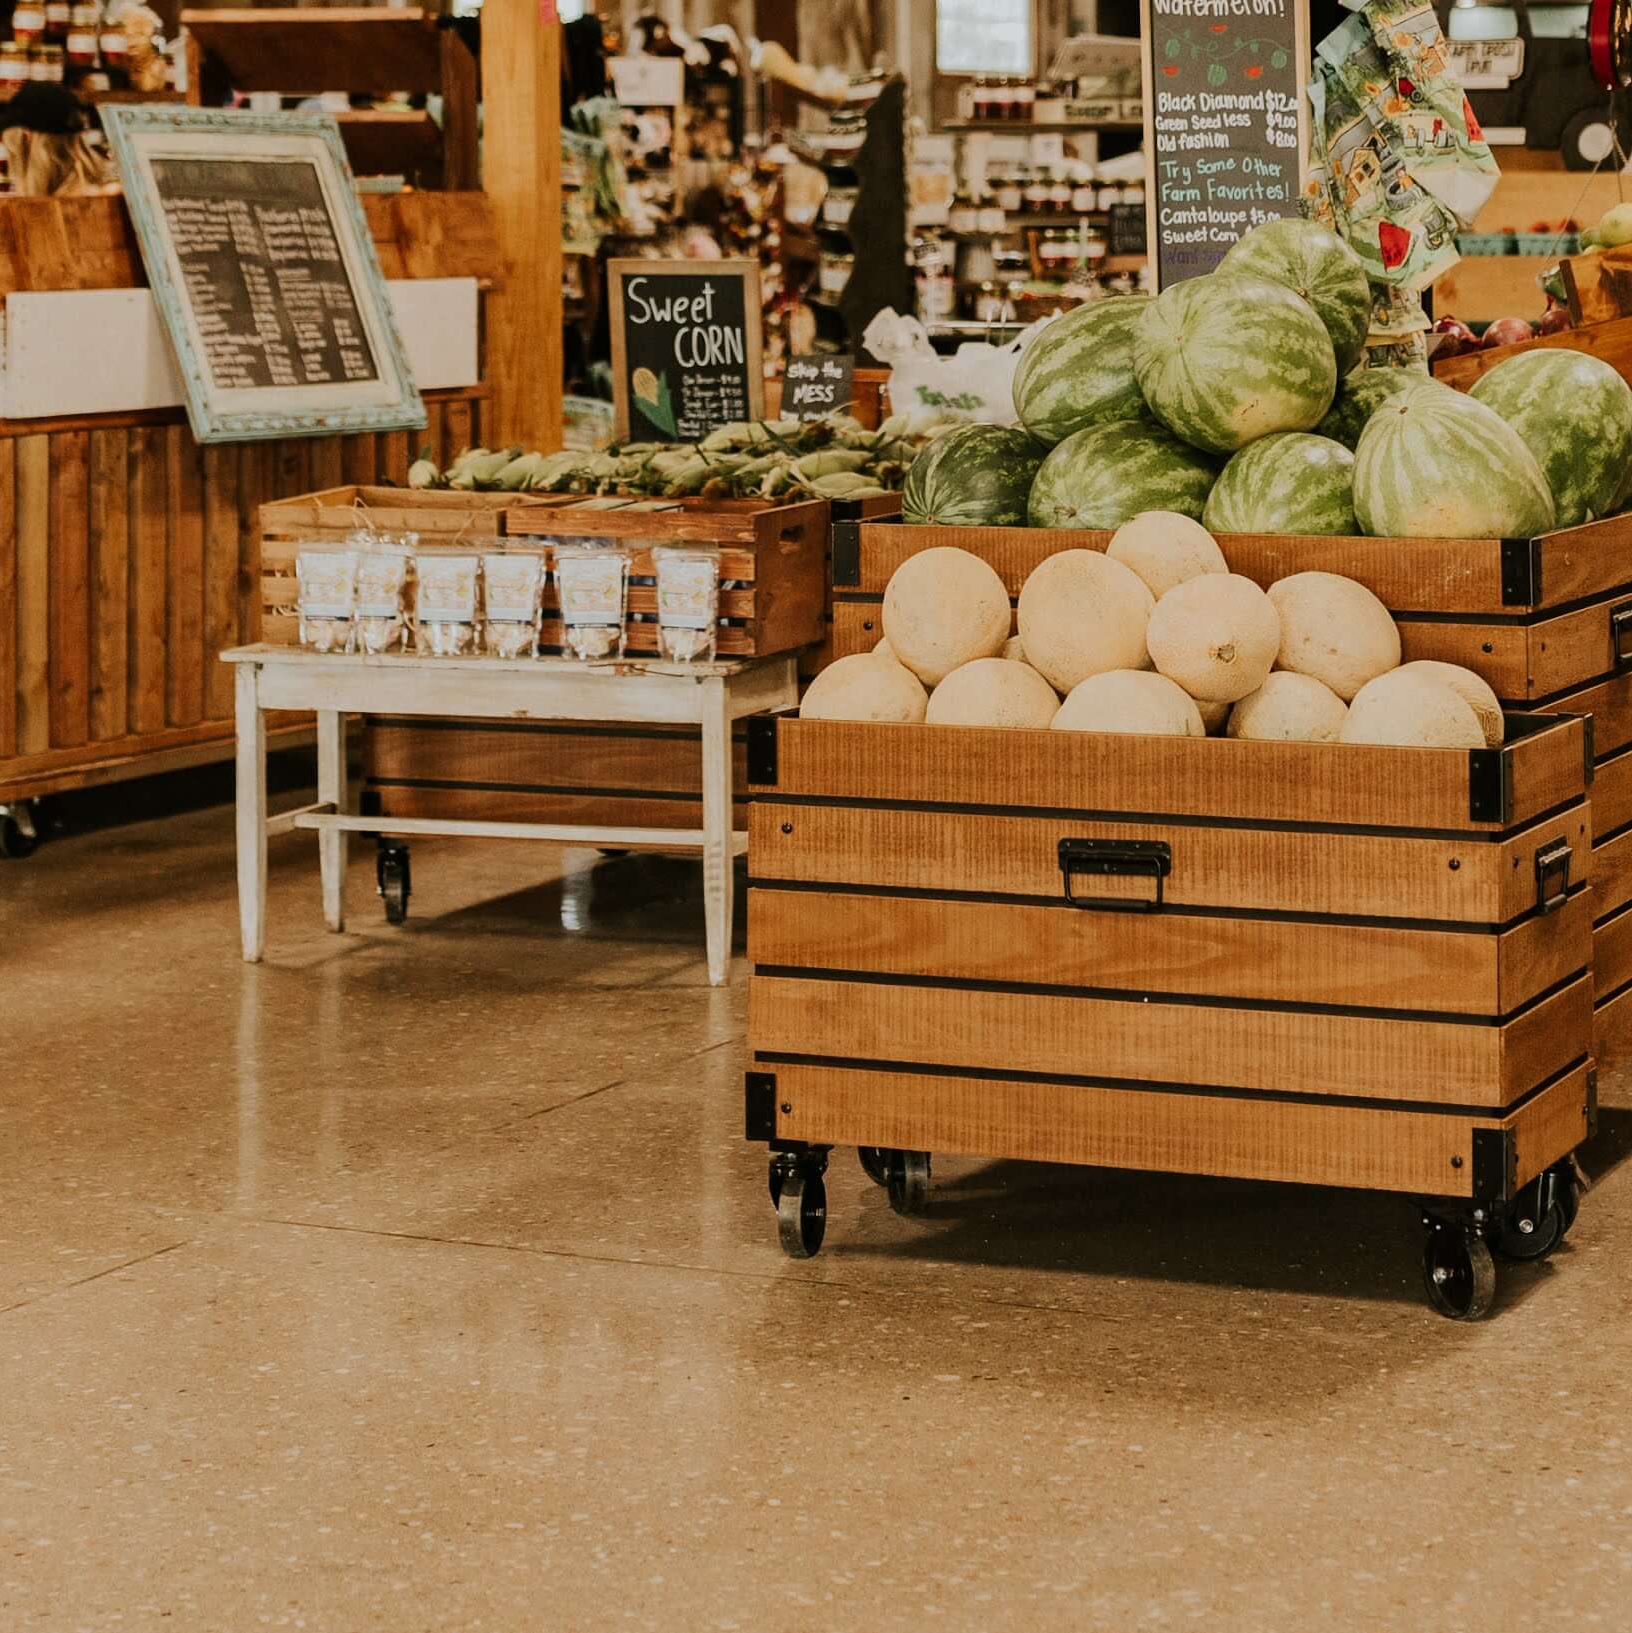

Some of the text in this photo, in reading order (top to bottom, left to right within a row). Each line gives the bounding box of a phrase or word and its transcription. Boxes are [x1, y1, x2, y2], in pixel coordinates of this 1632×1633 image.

[1158, 92, 1196, 112] Black
[1199, 90, 1265, 112] Diamond
[1155, 115, 1188, 130] Green
[1157, 134, 1177, 152] Old
[1160, 157, 1282, 185] Try Some Other
[1161, 177, 1290, 203] Farm Favorites!
[1160, 206, 1248, 229] Cantaloupe
[1163, 226, 1208, 245] Sweet
[1209, 227, 1240, 243] Corn
[627, 277, 716, 324] Sweet
[673, 325, 745, 368] CORN
[792, 383, 835, 405] MESS
